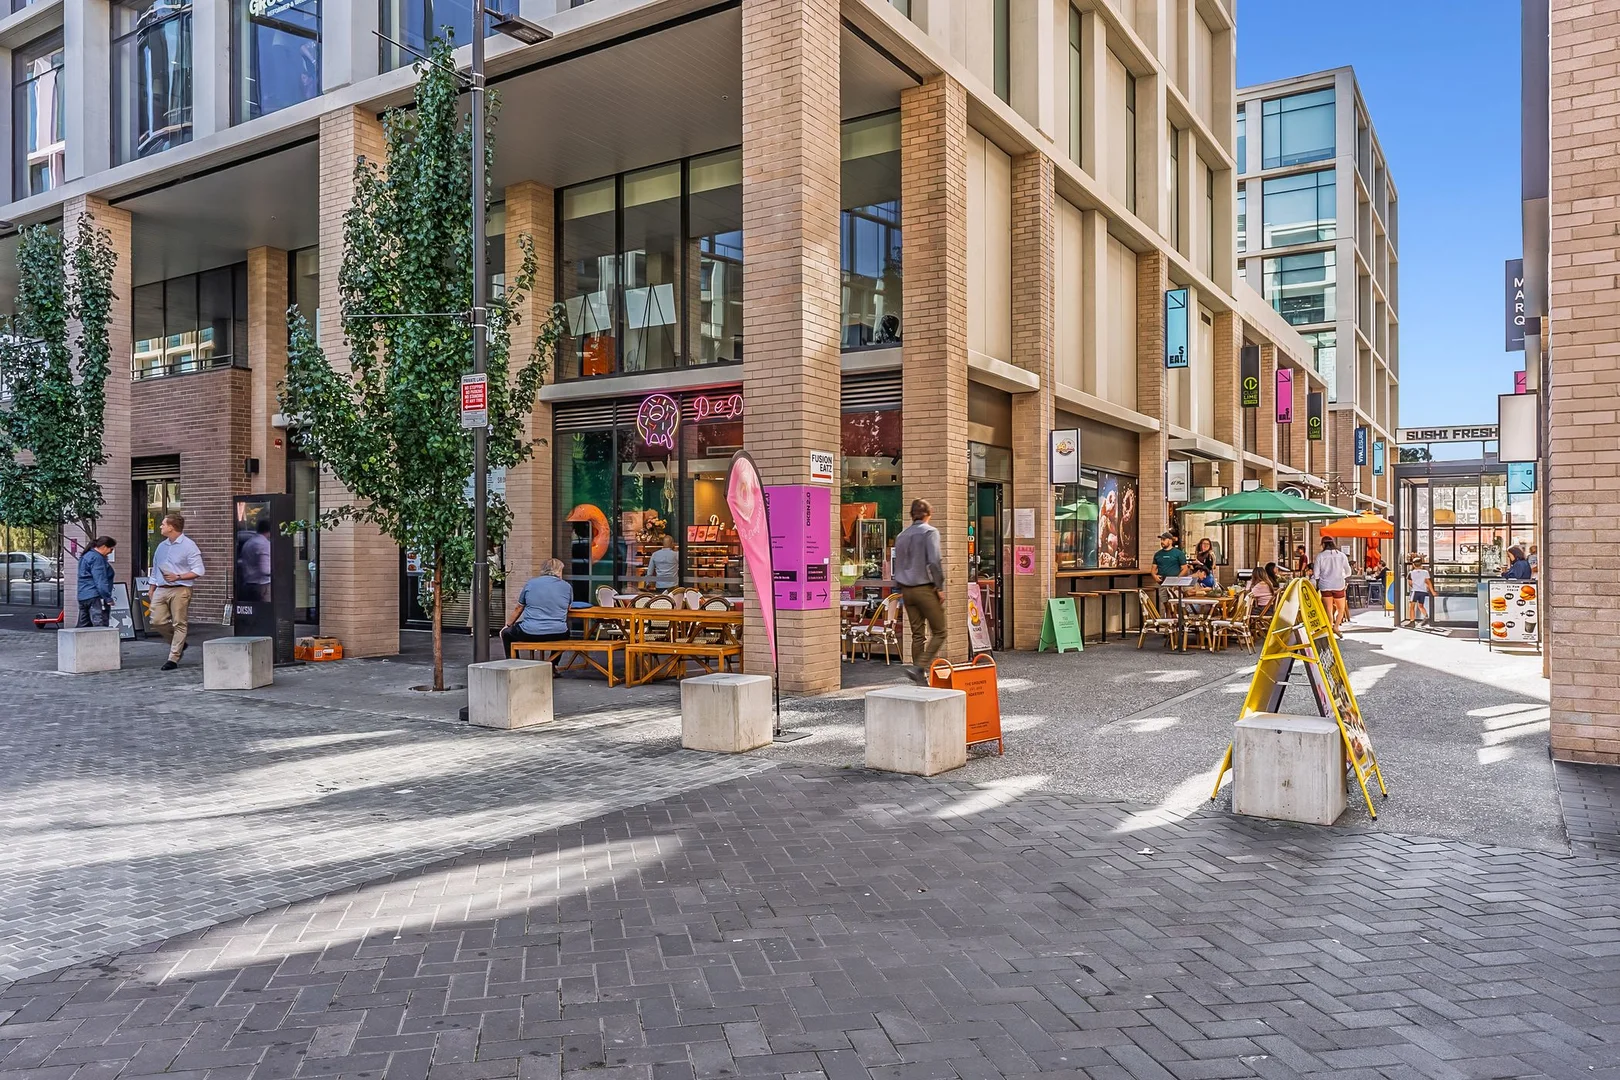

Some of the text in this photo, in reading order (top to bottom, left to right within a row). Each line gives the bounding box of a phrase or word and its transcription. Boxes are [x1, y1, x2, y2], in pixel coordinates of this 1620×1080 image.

[1513, 277, 1525, 325] MARQ
[1169, 355, 1186, 364] EAT.
[693, 394, 743, 421] DeD
[1406, 428, 1498, 440] SUSHI FRESH
[812, 454, 832, 464] FUSION
[820, 464, 832, 472] EATZ
[236, 606, 252, 614] DKSN
